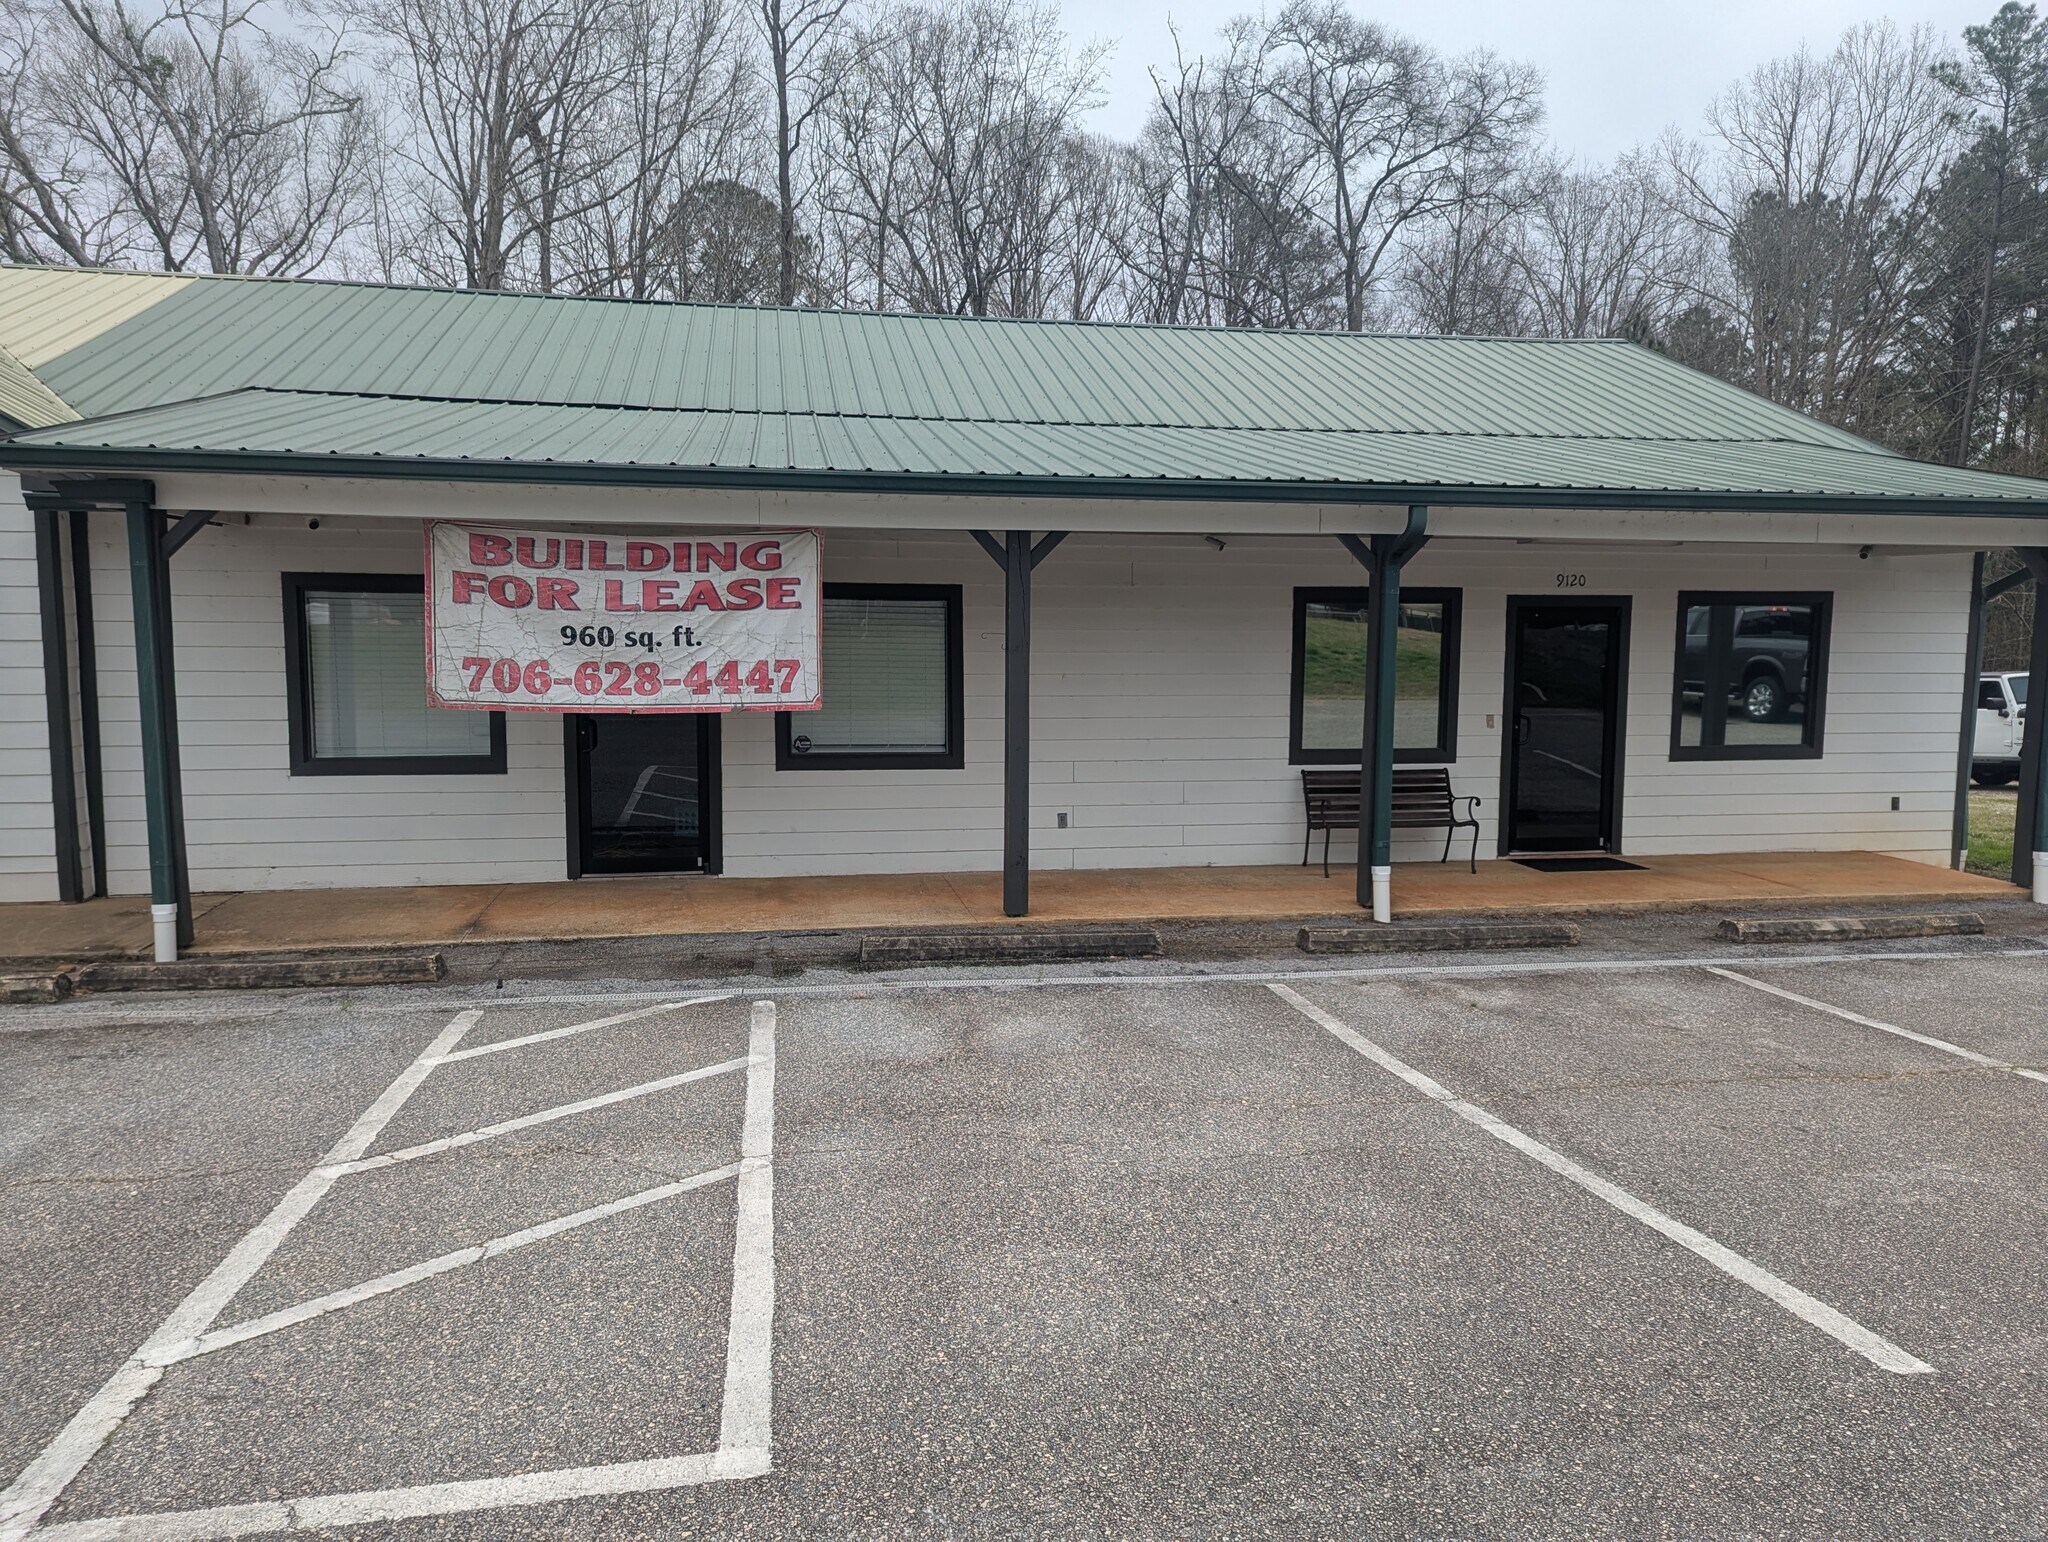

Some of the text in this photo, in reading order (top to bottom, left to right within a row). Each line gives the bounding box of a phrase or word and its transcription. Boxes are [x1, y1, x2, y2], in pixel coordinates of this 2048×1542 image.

[468, 533, 782, 572] BUILDING
[452, 570, 802, 612] FOR LEASE
[1556, 573, 1586, 588] 9120
[560, 625, 703, 653] 960 sq. ft.
[461, 657, 802, 696] 706-628-4447
